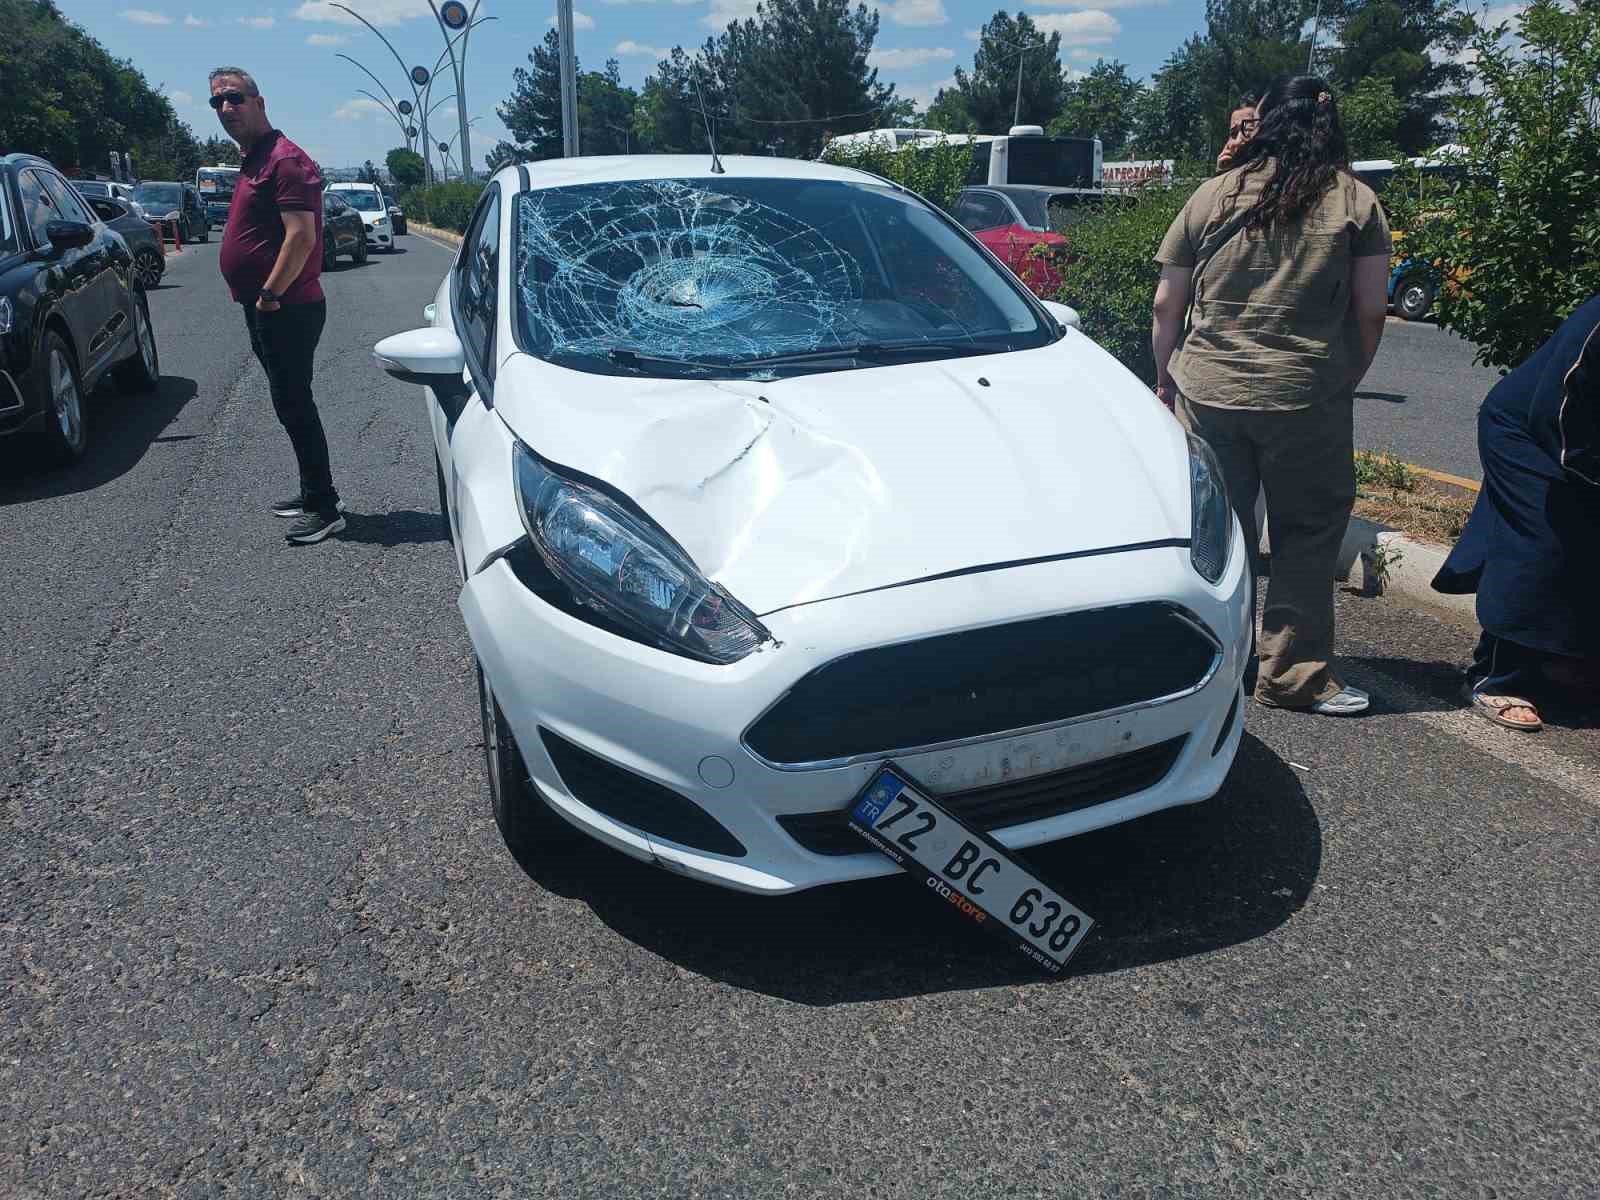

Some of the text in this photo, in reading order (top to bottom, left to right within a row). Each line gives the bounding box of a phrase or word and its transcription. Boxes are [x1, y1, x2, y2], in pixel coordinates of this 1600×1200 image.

[862, 801, 880, 820] TR
[876, 792, 1080, 952] 72 BC 638
